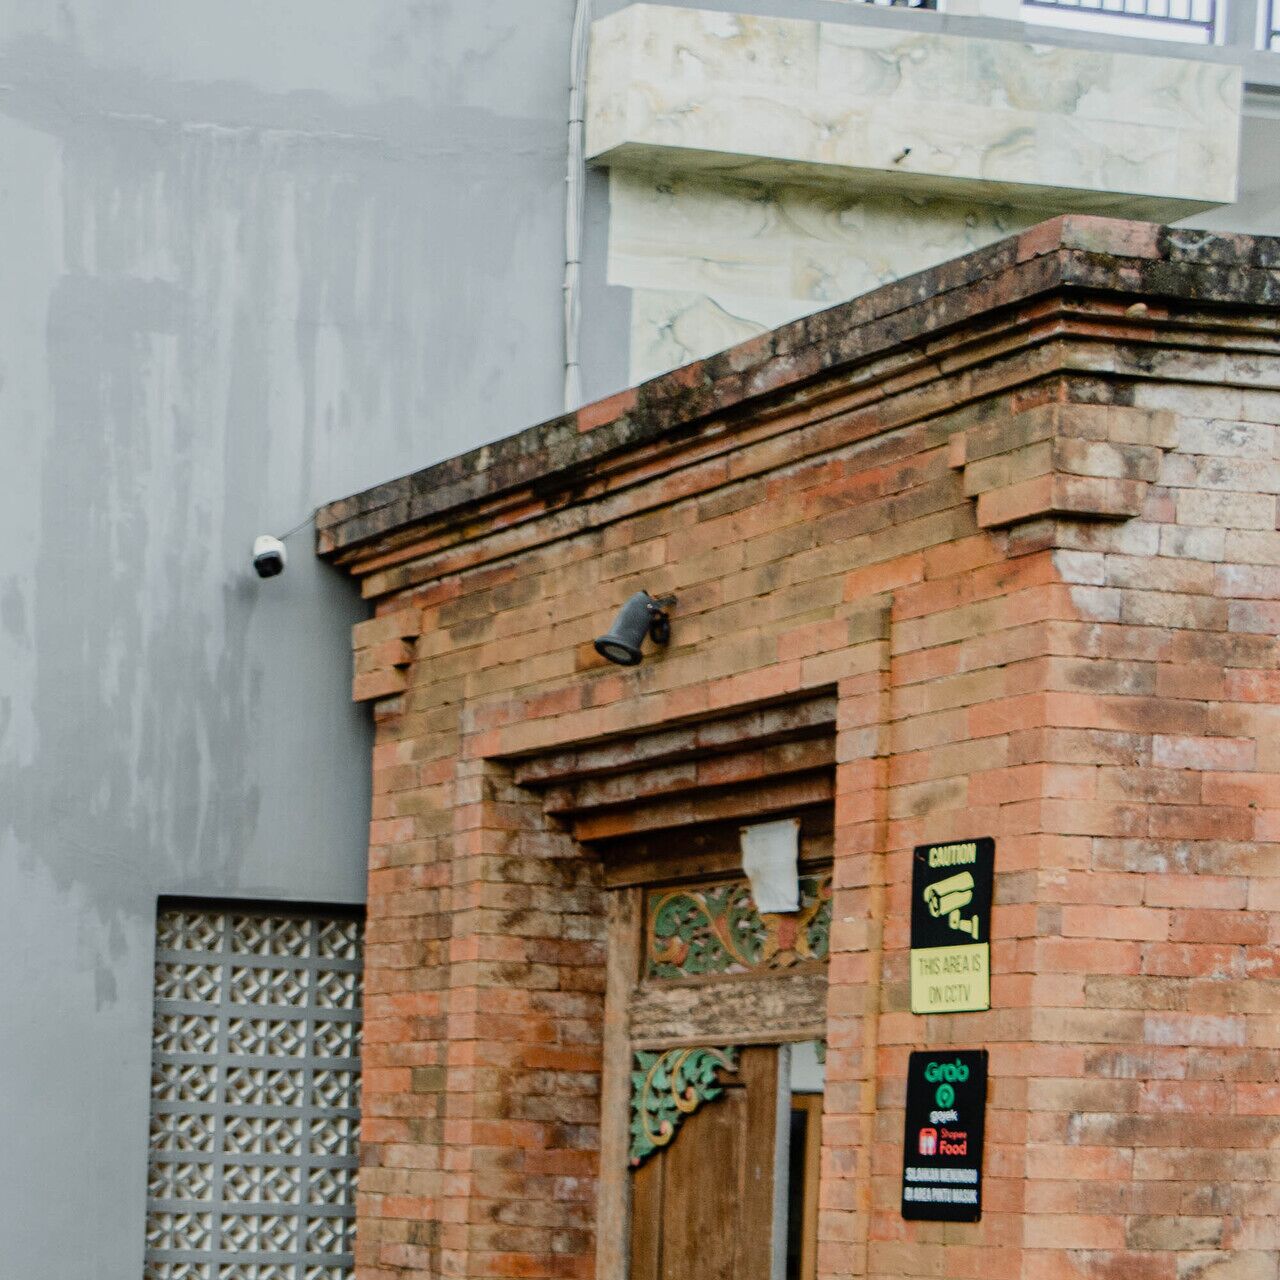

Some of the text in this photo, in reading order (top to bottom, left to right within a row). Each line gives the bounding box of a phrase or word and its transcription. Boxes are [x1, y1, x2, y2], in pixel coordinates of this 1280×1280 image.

[929, 843, 976, 868] CAUTION
[919, 953, 981, 976] THIS AREA IS
[928, 983, 971, 1004] ON CCTV
[924, 1058, 969, 1083] Grab
[930, 1109, 958, 1124] gojek
[941, 1128, 968, 1140] Shopee
[939, 1140, 967, 1155] Food
